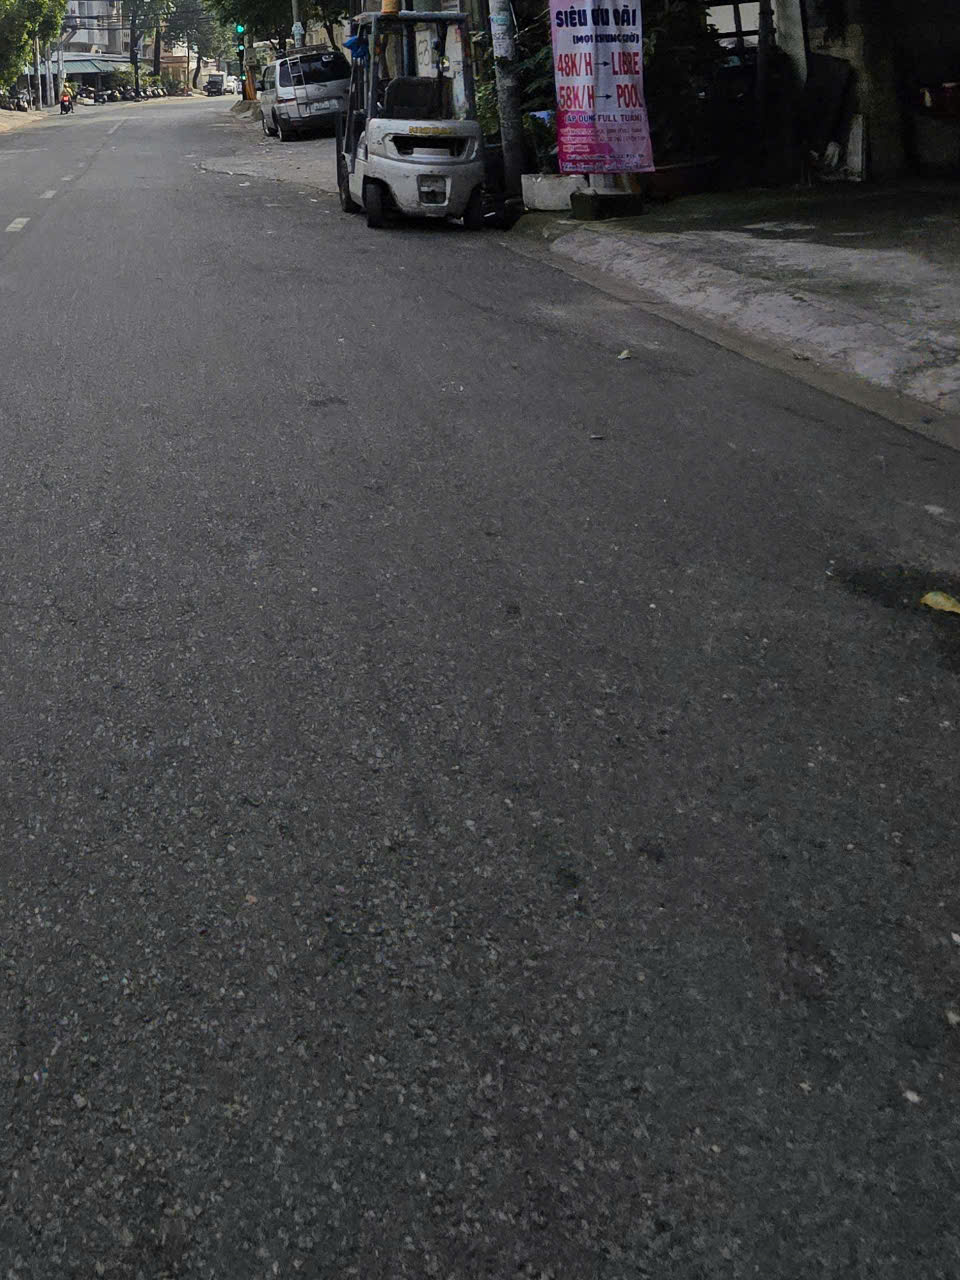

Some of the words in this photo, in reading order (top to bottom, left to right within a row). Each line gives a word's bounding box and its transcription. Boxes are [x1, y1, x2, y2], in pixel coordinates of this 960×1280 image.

[555, 5, 588, 28] SIÊU
[557, 52, 593, 77] 48K/H
[611, 51, 641, 76] LIBRE
[559, 84, 596, 111] 58K/H
[598, 114, 618, 123] FULL
